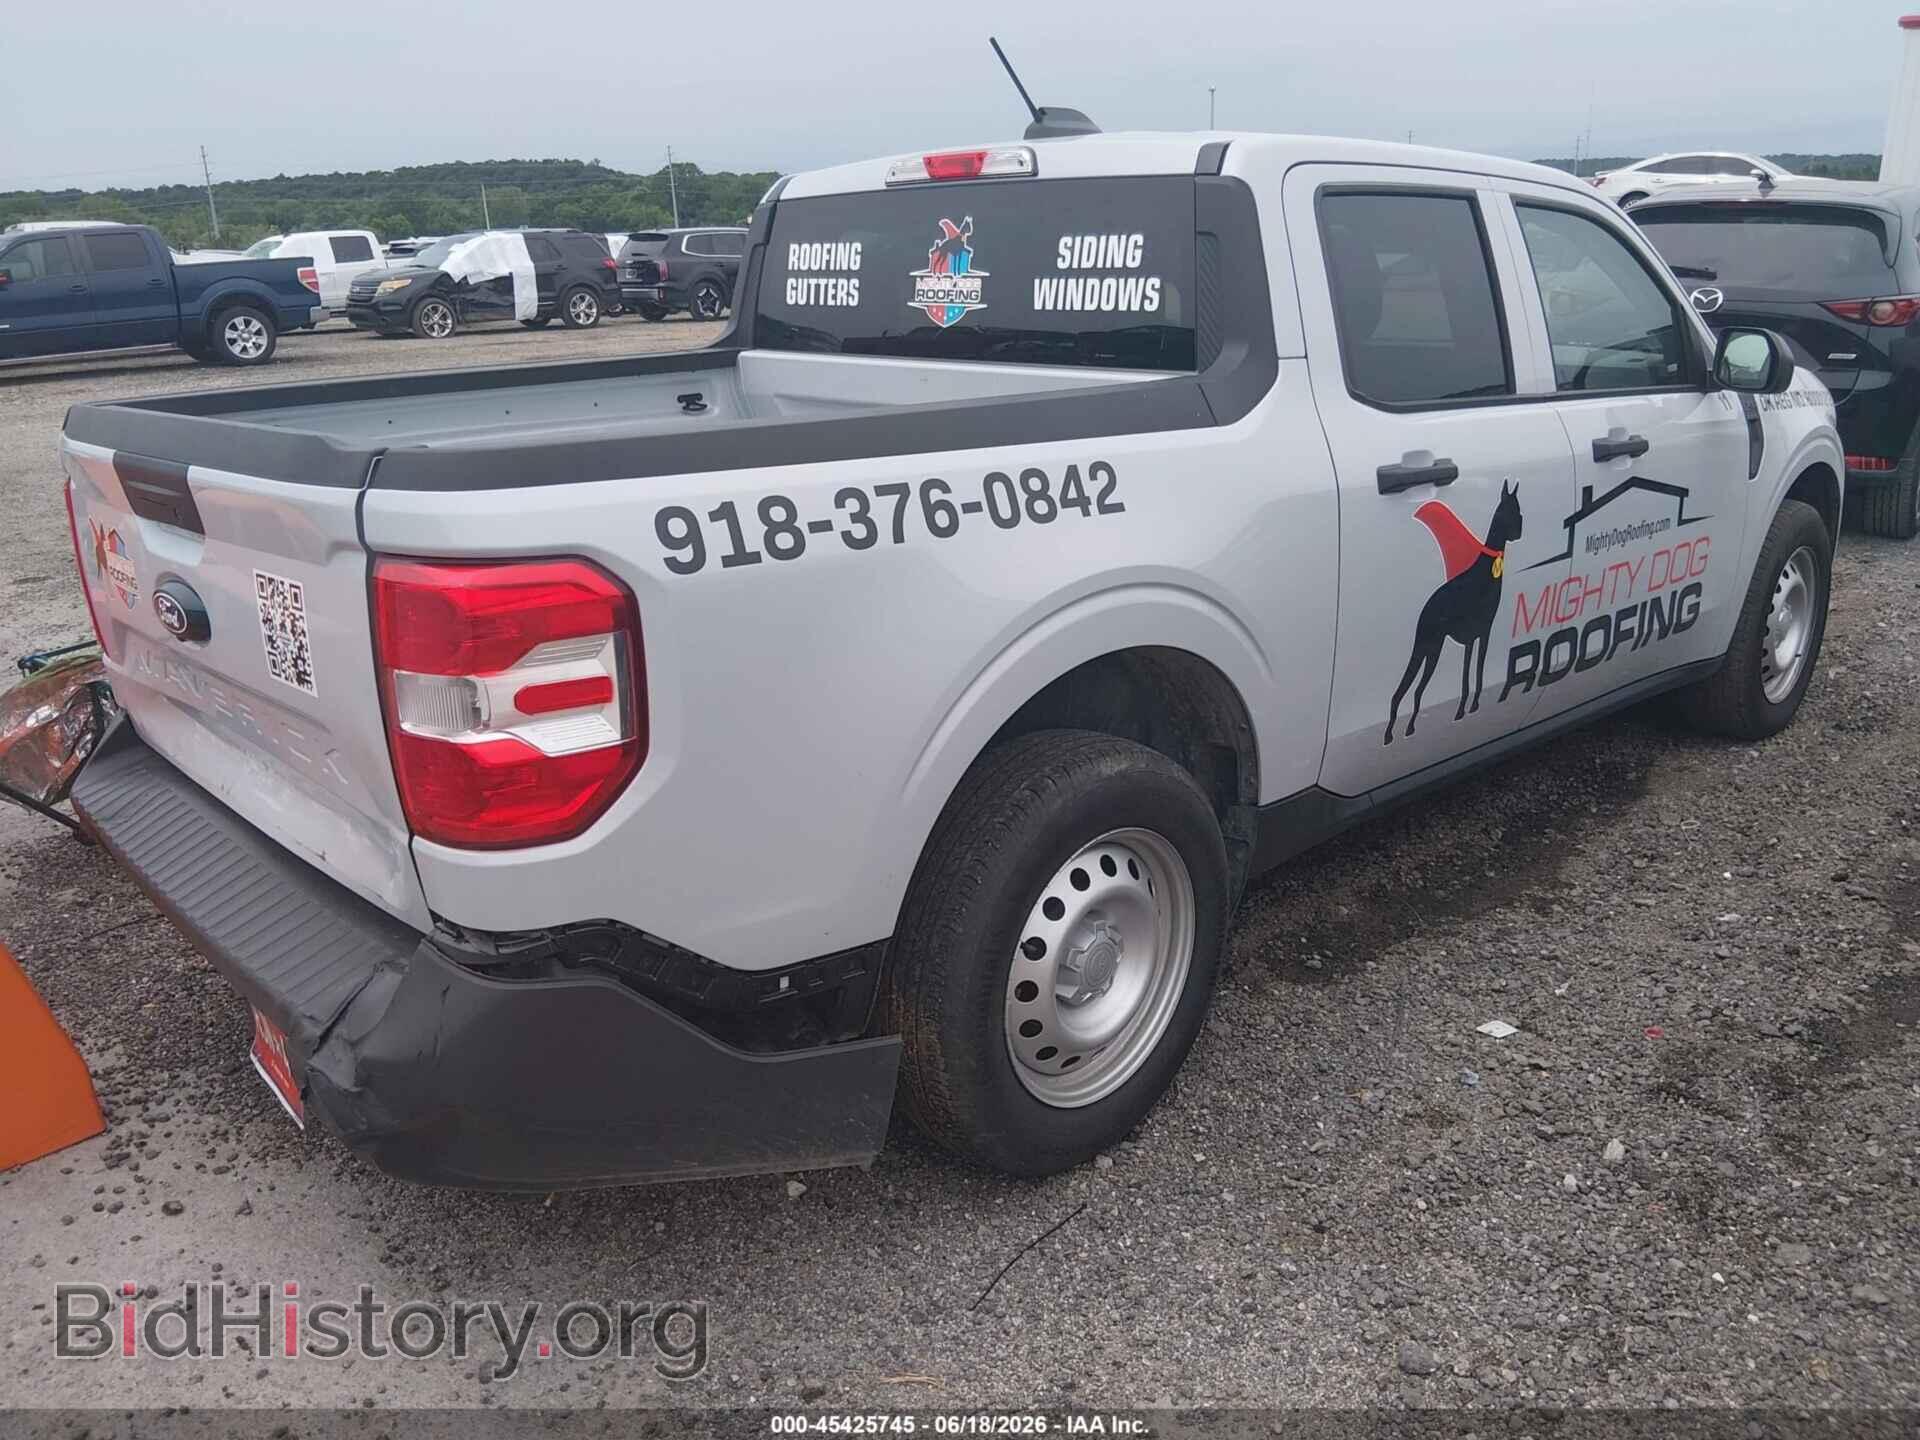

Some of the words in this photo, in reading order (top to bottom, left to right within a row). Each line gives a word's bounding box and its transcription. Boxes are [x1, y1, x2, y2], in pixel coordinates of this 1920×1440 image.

[787, 242, 863, 272] ROOFING
[1056, 233, 1144, 270] SIDING
[786, 278, 860, 307] GUTTERS
[916, 288, 980, 301] ROOFING
[1033, 277, 1161, 312] WINDOWS
[654, 460, 1126, 576] 918-376-0842
[1585, 517, 1671, 555] MightyDogRoofing.com
[1511, 556, 1645, 639] MIGHTY
[1647, 536, 1710, 593] DOG
[1498, 582, 1697, 703] ROOFING
